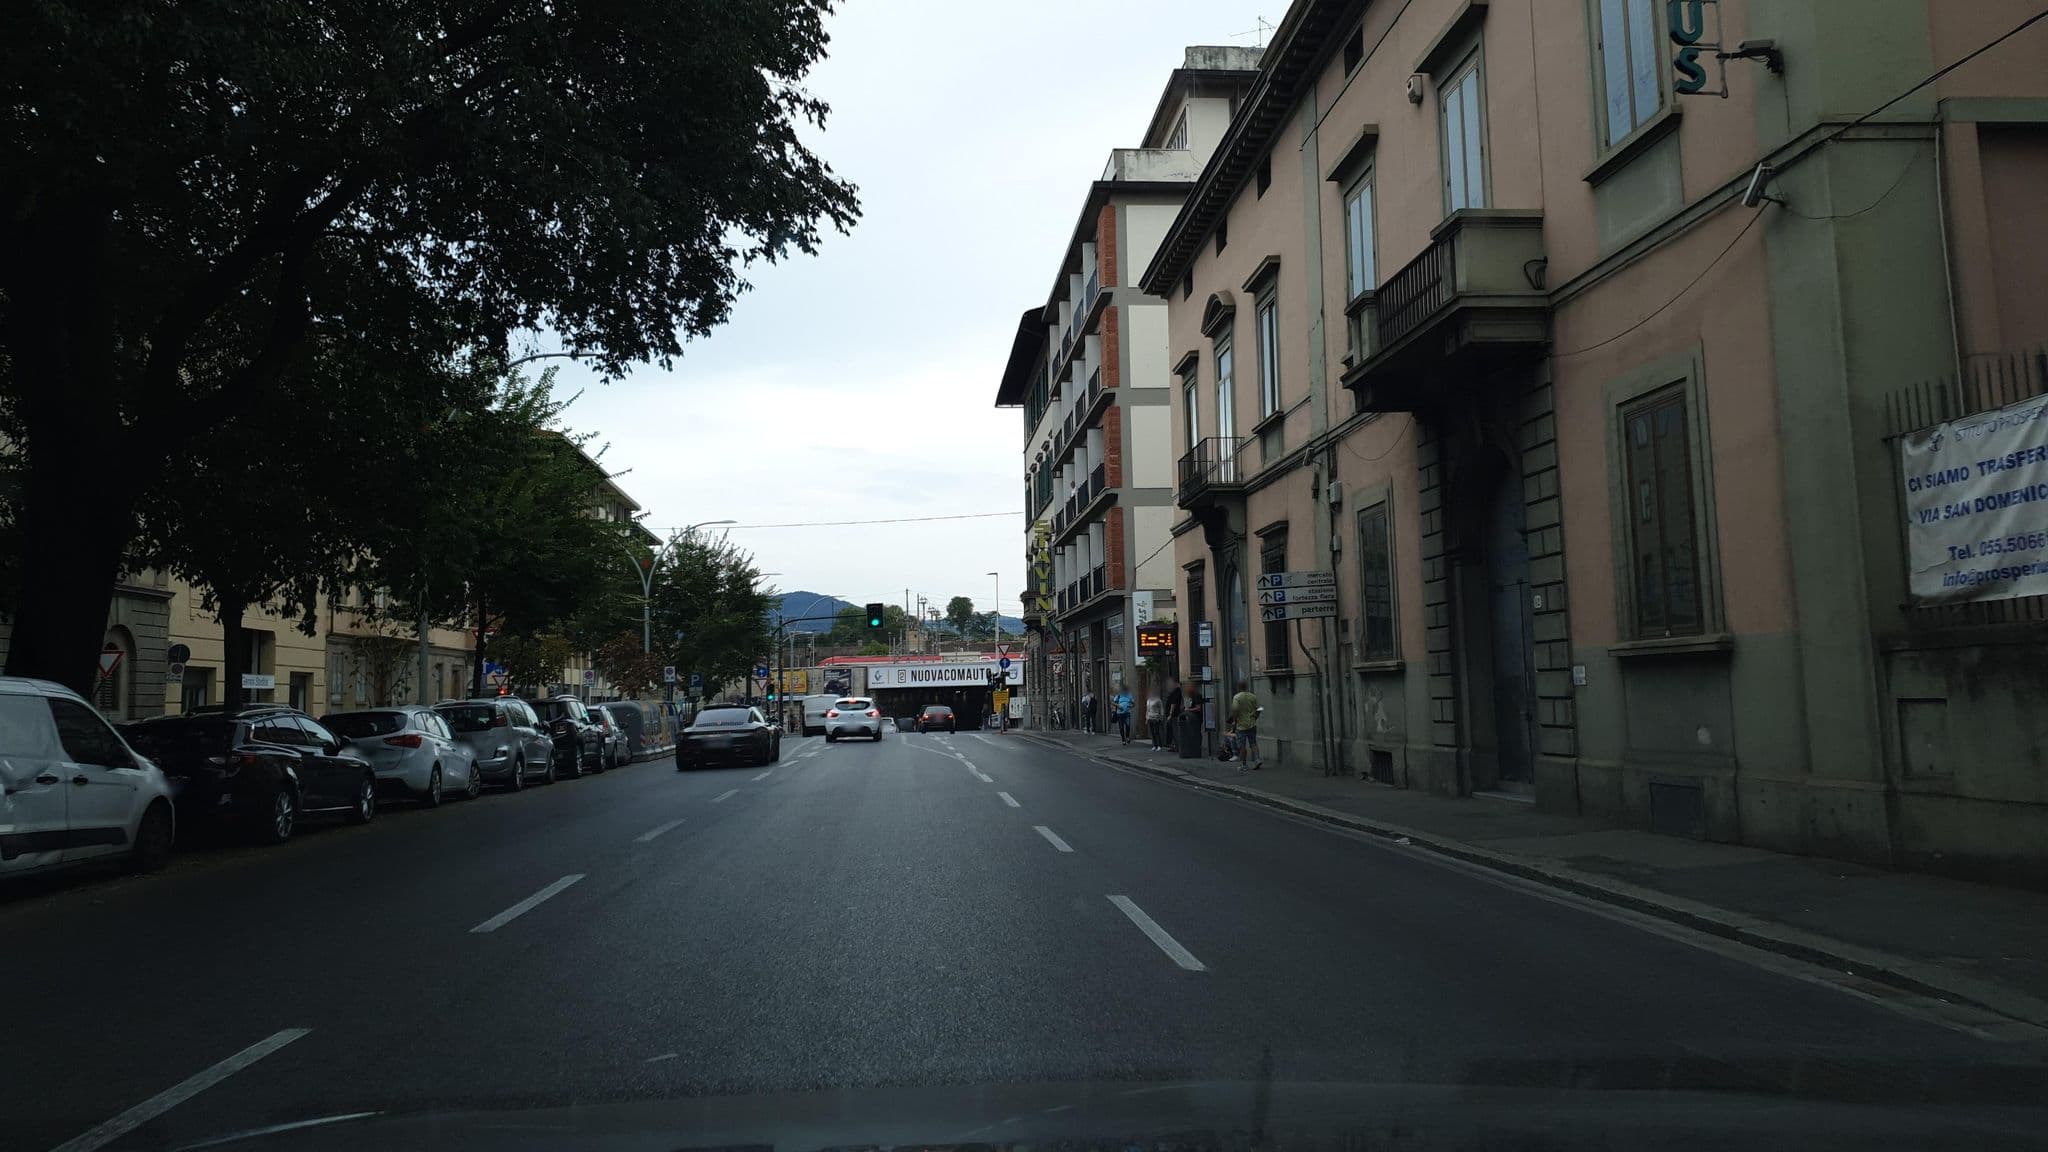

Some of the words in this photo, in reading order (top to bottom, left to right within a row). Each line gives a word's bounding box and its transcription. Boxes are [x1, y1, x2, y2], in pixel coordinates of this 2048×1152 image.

[1908, 477, 1922, 492] CI
[1926, 466, 1969, 488] SIAMO
[1976, 445, 2048, 477] TRASFER
[1919, 506, 1940, 524] VIA
[1944, 500, 1970, 519] SAN
[1975, 483, 2048, 513] DOMENIC
[1948, 545, 1976, 560] Tel.
[1980, 532, 2048, 557] 055.5066
[1302, 605, 1335, 615] parterre
[911, 667, 992, 682] NUOVACOMAUTO
